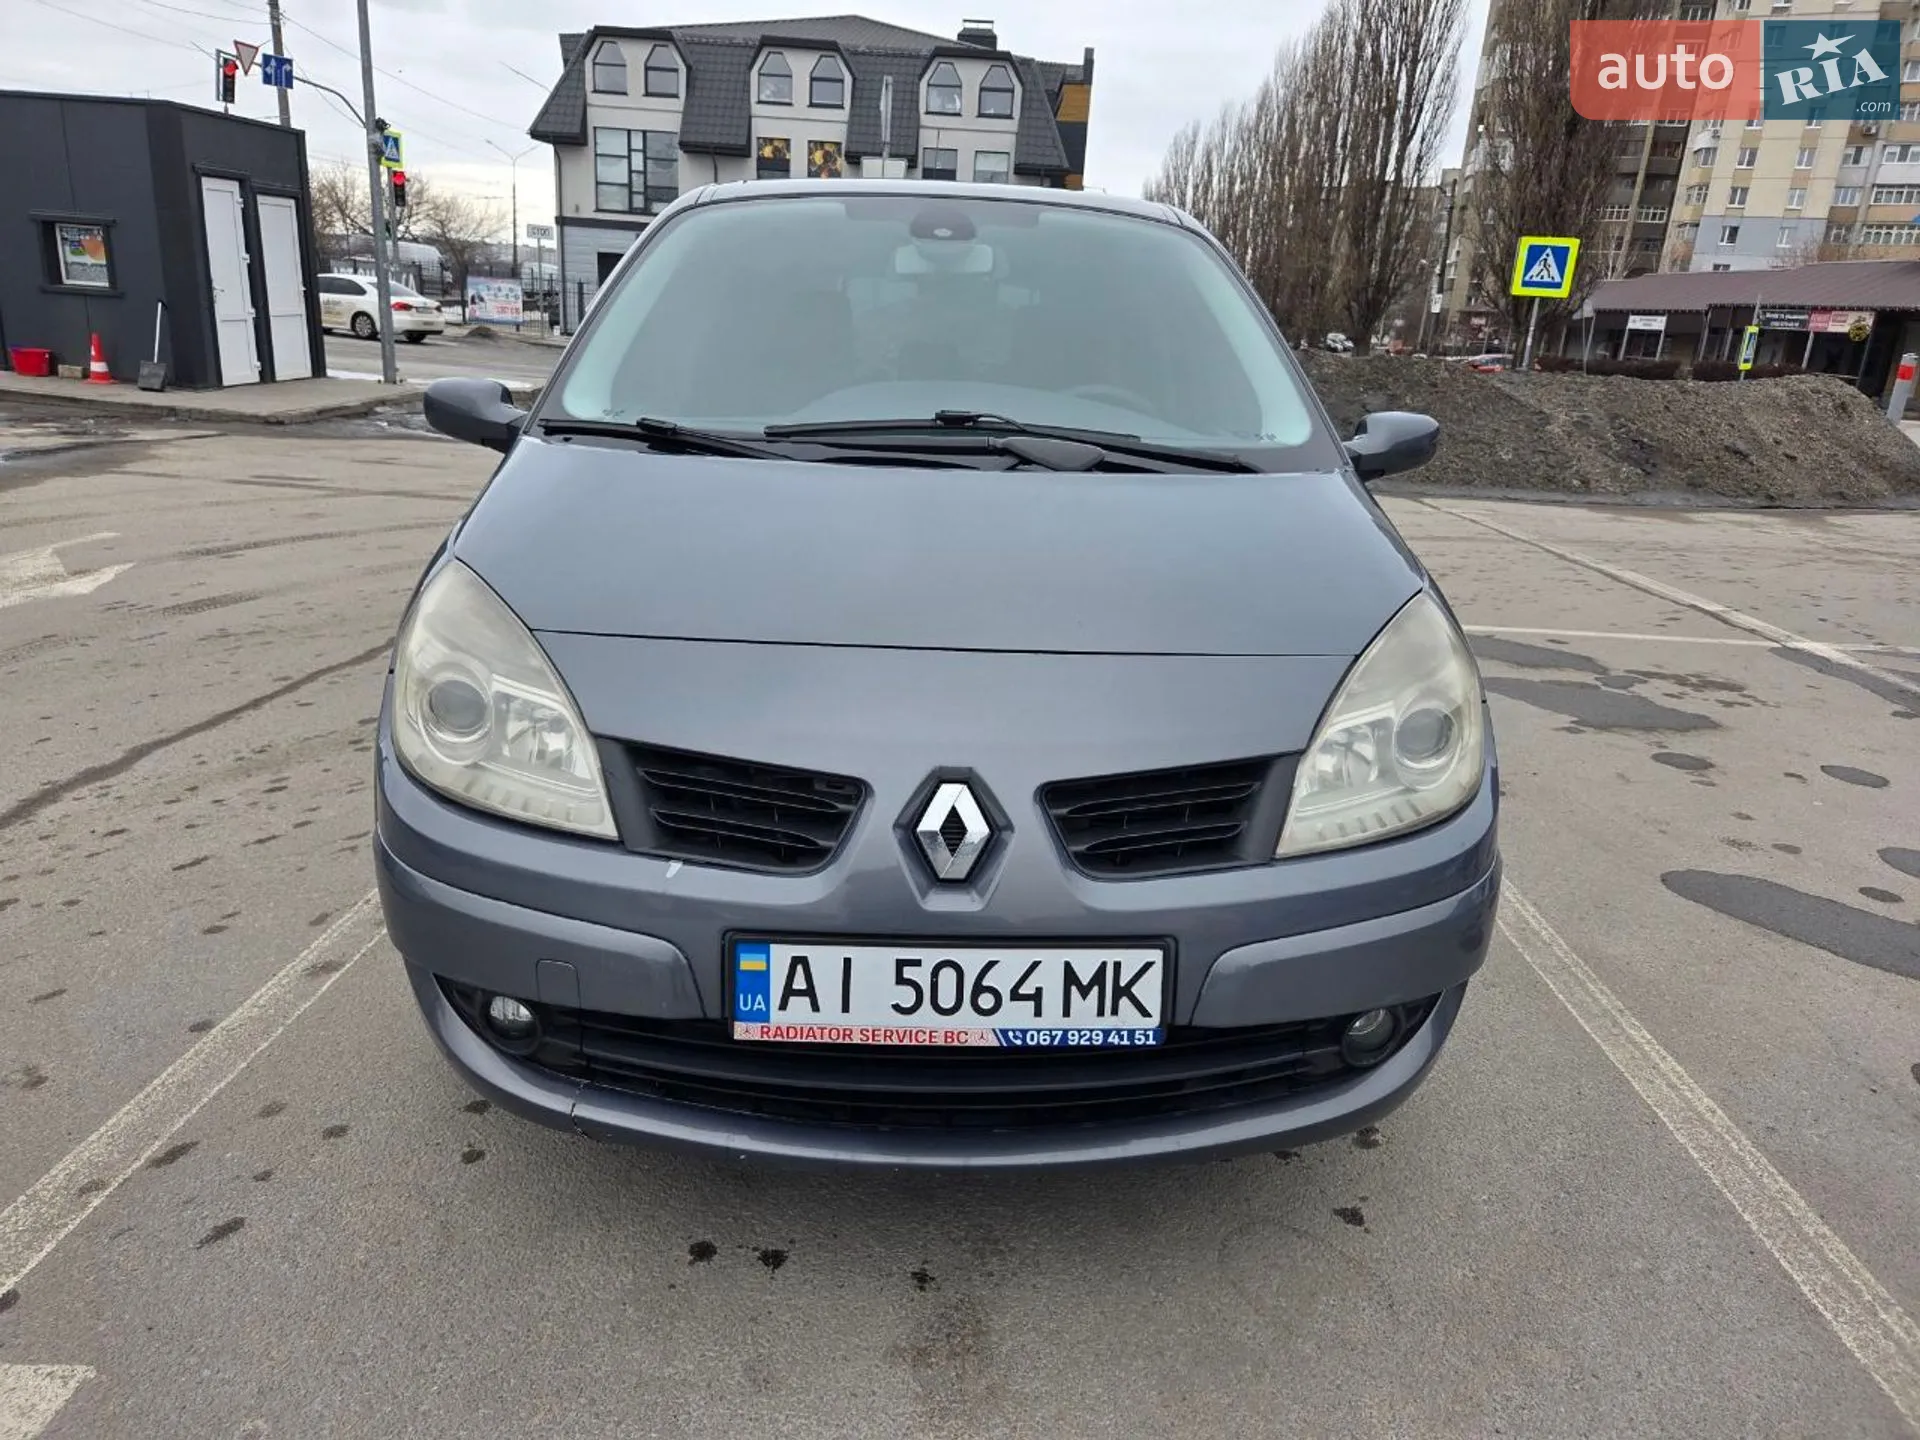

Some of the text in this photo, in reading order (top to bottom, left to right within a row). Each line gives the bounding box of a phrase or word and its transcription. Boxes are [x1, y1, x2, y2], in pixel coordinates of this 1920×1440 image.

[891, 958, 1043, 1018] 5064
[1062, 960, 1155, 1018] MK
[739, 993, 766, 1011] UA
[760, 1025, 968, 1045] RADIATOR SERVICE BC
[1026, 1030, 1156, 1046] 067 929 41 51
